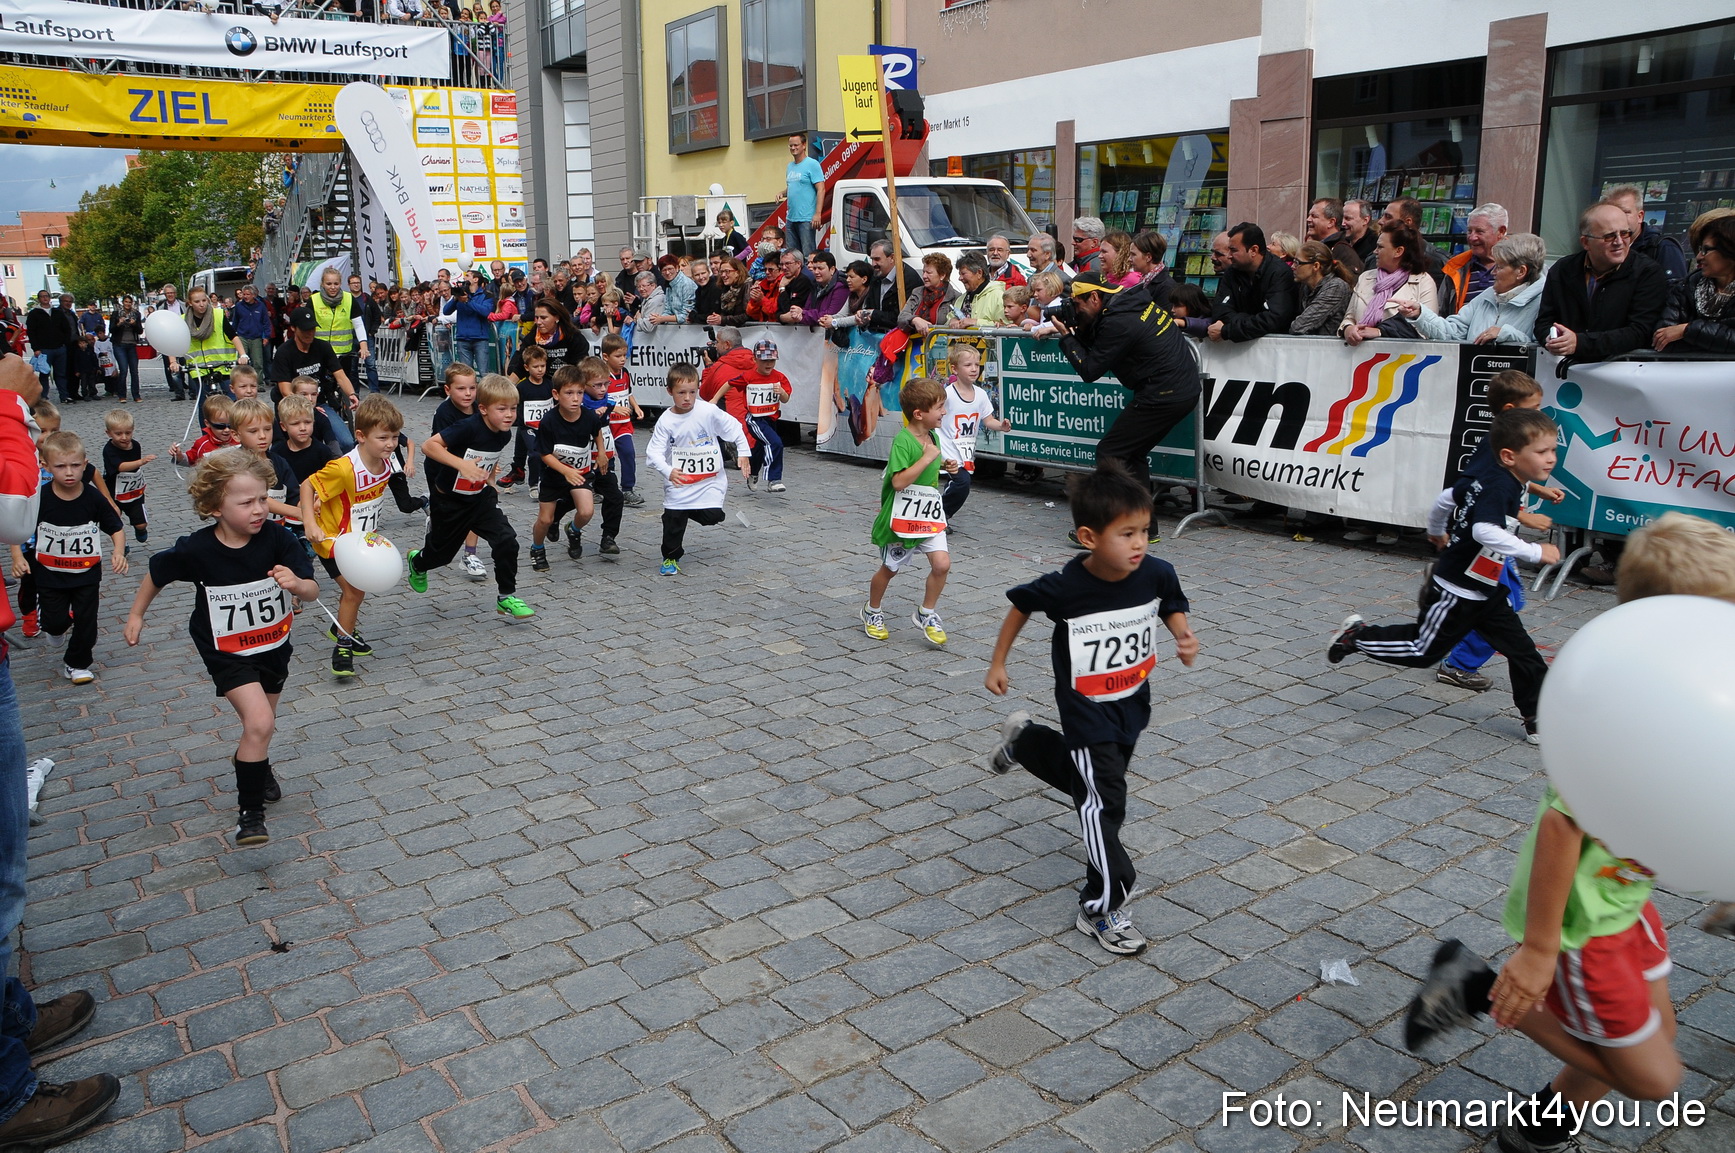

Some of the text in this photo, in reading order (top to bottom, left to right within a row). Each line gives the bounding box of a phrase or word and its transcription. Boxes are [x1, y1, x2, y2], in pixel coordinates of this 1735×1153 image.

[0, 13, 115, 42] Laufsport
[264, 36, 408, 60] BMW Laufsport
[843, 79, 878, 95] Jugend
[24, 101, 70, 112] Stadtlauf
[128, 88, 228, 125] ZIEL
[855, 95, 874, 108] lauf
[278, 113, 325, 121] Neumarkter
[944, 118, 961, 129] Markt
[963, 116, 970, 127] 15
[1030, 351, 1070, 363] Event-Le
[751, 392, 778, 404] 7149
[1008, 383, 1125, 410] Mehr Sicherheit
[1009, 406, 1105, 433] für Ihr Event!
[1009, 440, 1096, 461] Miet & Service Line:
[678, 457, 715, 473] 7313
[1232, 457, 1364, 493] neumarkt
[354, 490, 376, 503] MAX
[352, 505, 371, 514] PARTL
[902, 497, 941, 520] 7148
[40, 526, 58, 536] PARTL
[907, 522, 932, 532] Tobias
[45, 535, 94, 555] 7143
[54, 558, 83, 567] Niclas
[209, 584, 280, 602] PARTL Neumark
[219, 590, 286, 631] 7151
[1072, 613, 1150, 637] PARTL Neumarkt
[239, 626, 283, 647] Hannes
[1084, 626, 1151, 672] 7239
[1105, 671, 1140, 691] Oliver
